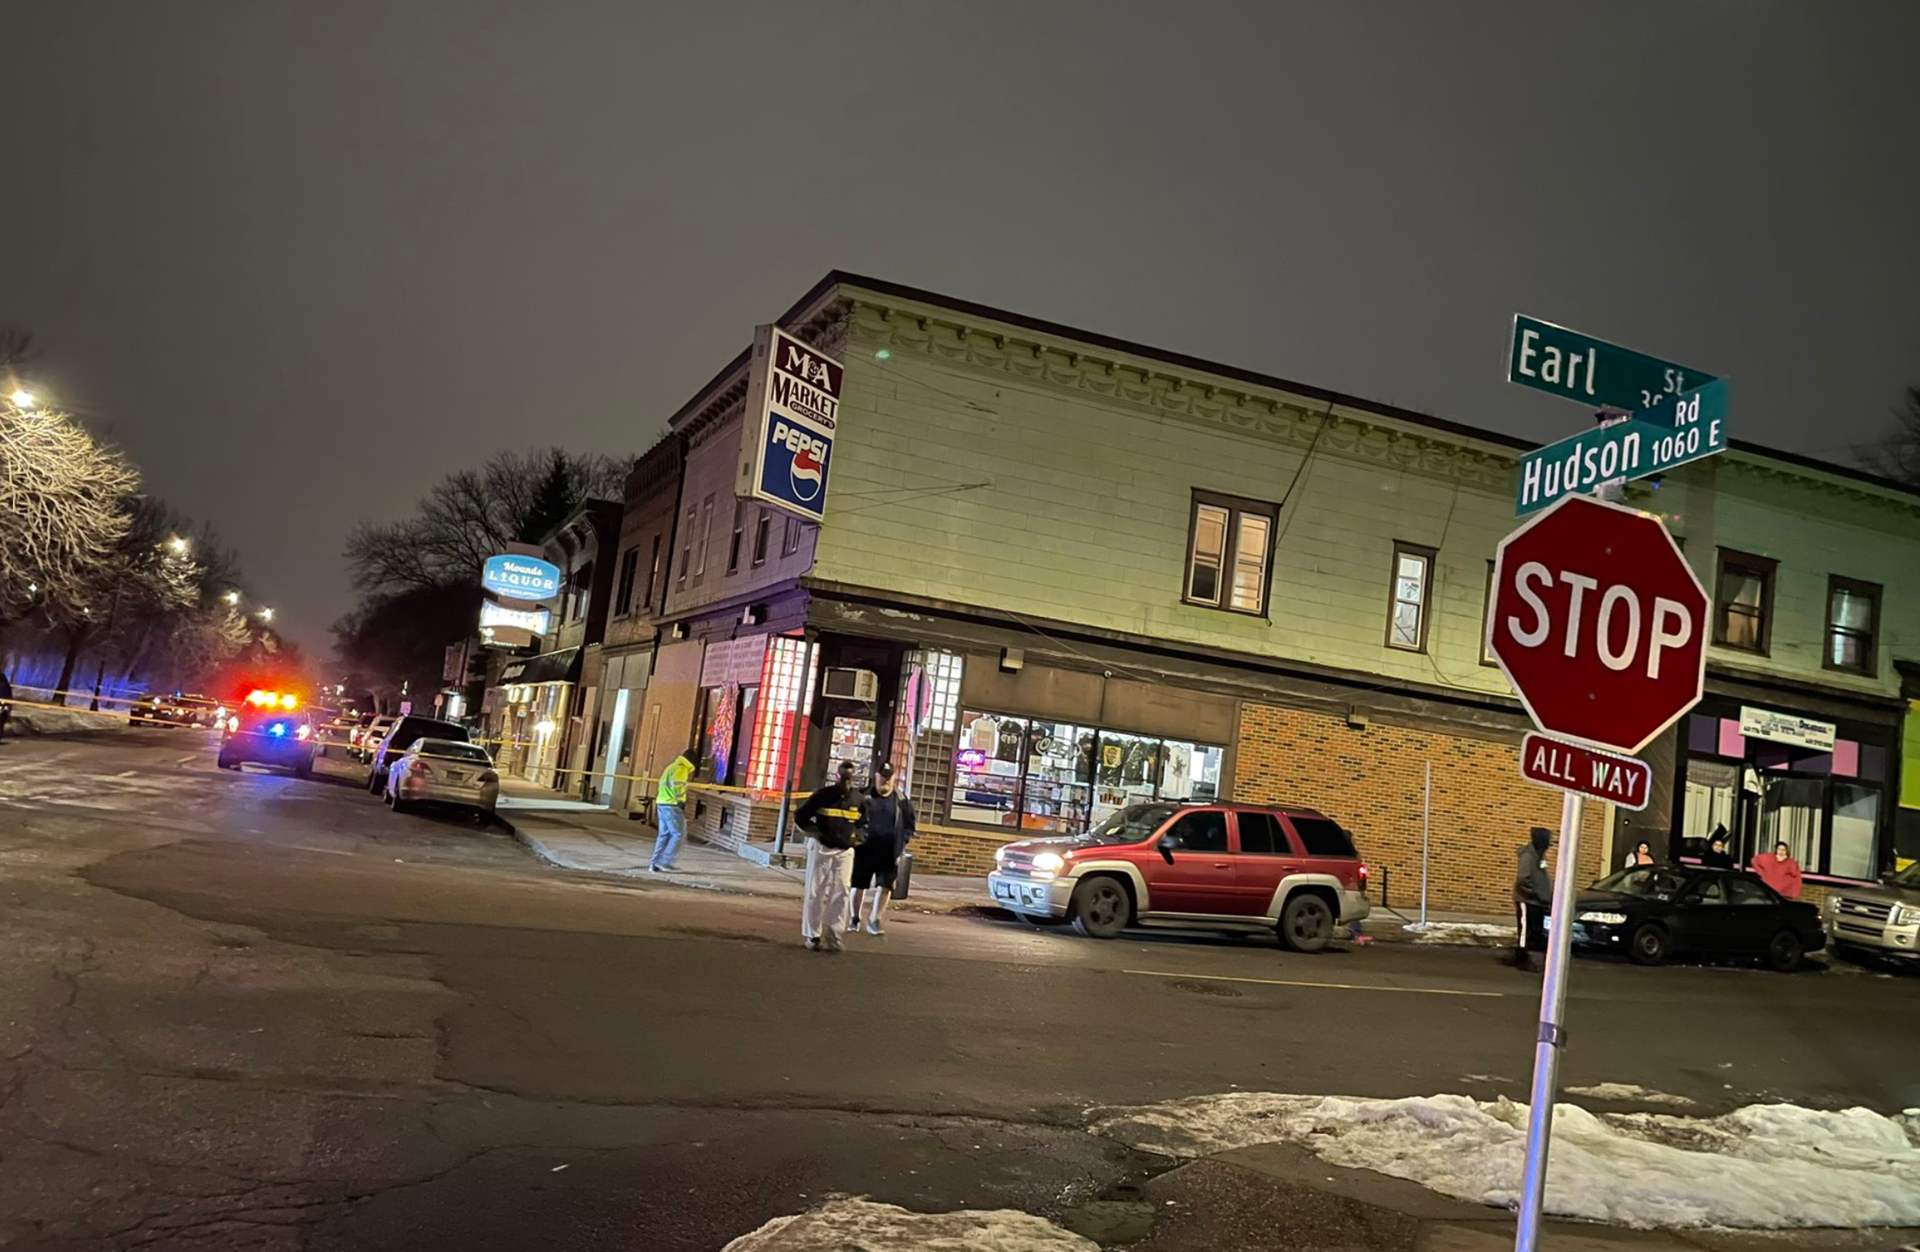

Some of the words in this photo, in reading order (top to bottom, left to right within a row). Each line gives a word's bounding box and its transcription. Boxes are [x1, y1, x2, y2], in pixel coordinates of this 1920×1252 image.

[785, 346, 832, 392] M&A
[1518, 329, 1596, 395] Earl
[1663, 369, 1685, 396] St
[771, 371, 838, 419] MARKET
[772, 421, 828, 464] PEPSI
[1522, 431, 1640, 506] Hudson
[1675, 393, 1700, 428] Rd
[1652, 427, 1700, 466] 1060
[1709, 419, 1721, 447] E
[488, 570, 554, 590] LIQUOR
[503, 561, 543, 576] Mounds
[1508, 561, 1692, 679] STOP
[1532, 745, 1576, 782] ALL
[1591, 760, 1640, 797] WAY
